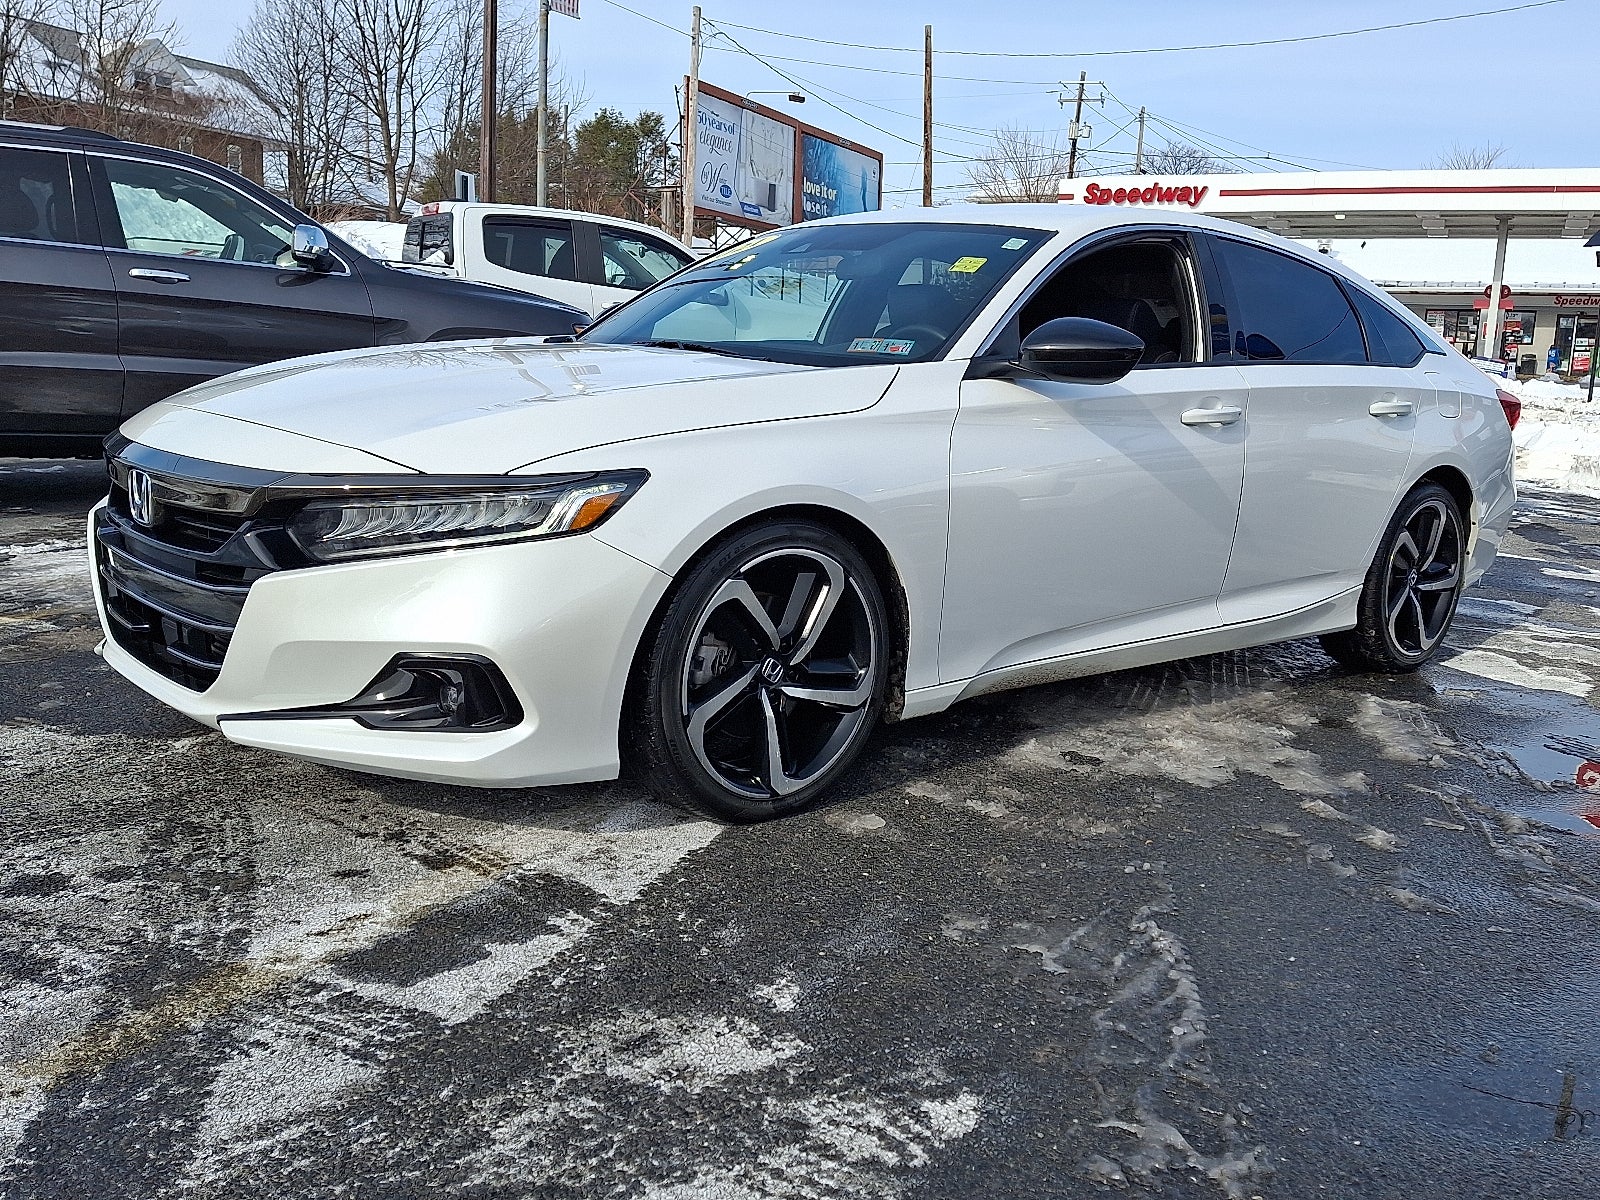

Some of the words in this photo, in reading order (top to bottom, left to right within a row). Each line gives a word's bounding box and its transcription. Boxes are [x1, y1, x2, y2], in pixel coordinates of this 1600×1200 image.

[707, 117, 728, 133] years
[728, 122, 736, 135] of
[699, 126, 734, 156] elegance
[803, 177, 821, 196] love
[821, 182, 828, 198] it
[828, 189, 838, 201] or
[1084, 182, 1209, 208] Speedway
[803, 196, 821, 214] lose
[821, 200, 828, 216] it
